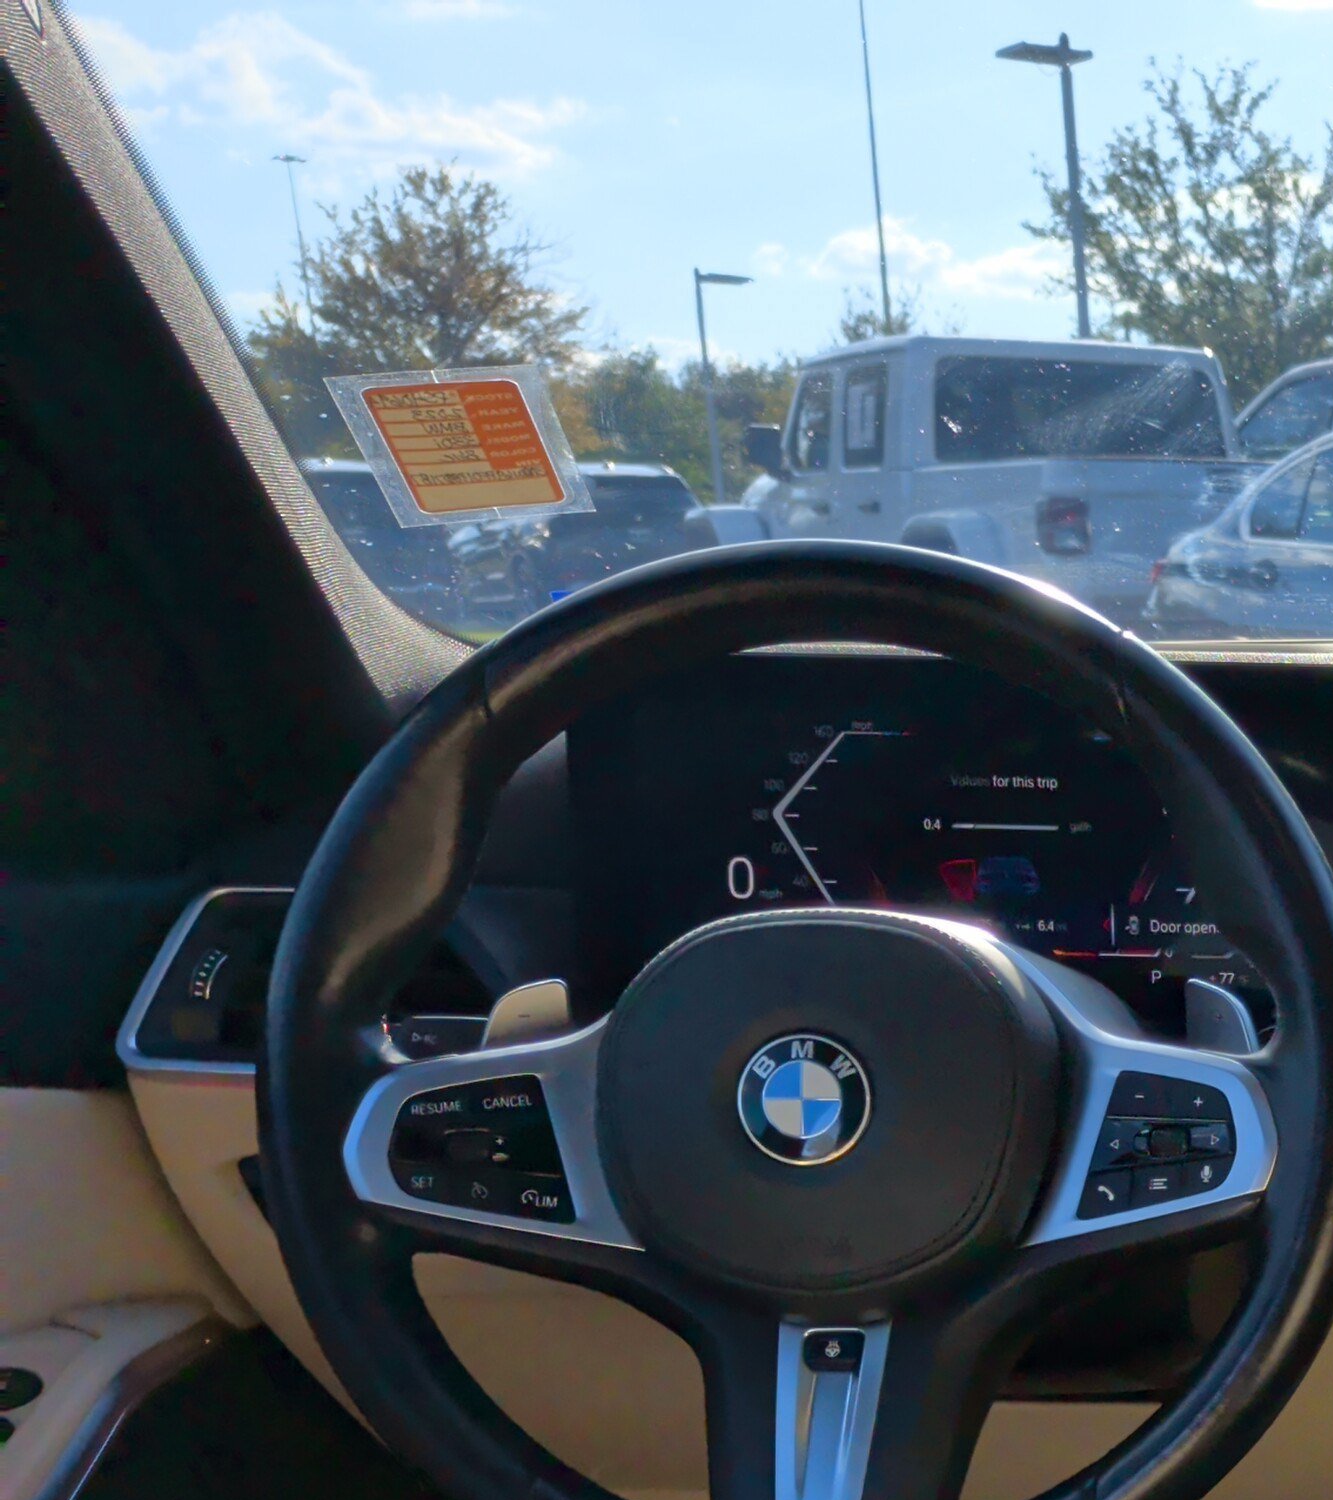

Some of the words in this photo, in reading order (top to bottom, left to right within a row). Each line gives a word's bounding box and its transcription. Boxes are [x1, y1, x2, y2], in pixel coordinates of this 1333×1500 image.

[992, 775, 1009, 787] for
[1012, 776, 1035, 788] this
[1037, 776, 1059, 791] trip
[922, 818, 942, 831] 0.4
[727, 856, 756, 900] 0
[1037, 919, 1055, 932] 6.4
[1150, 919, 1181, 933] Door
[1184, 923, 1221, 936] open.
[1151, 970, 1162, 984] P
[752, 1040, 857, 1080] BMW
[411, 1100, 462, 1116] RESUME
[483, 1096, 533, 1110] CANCEL
[411, 1176, 433, 1188] SET
